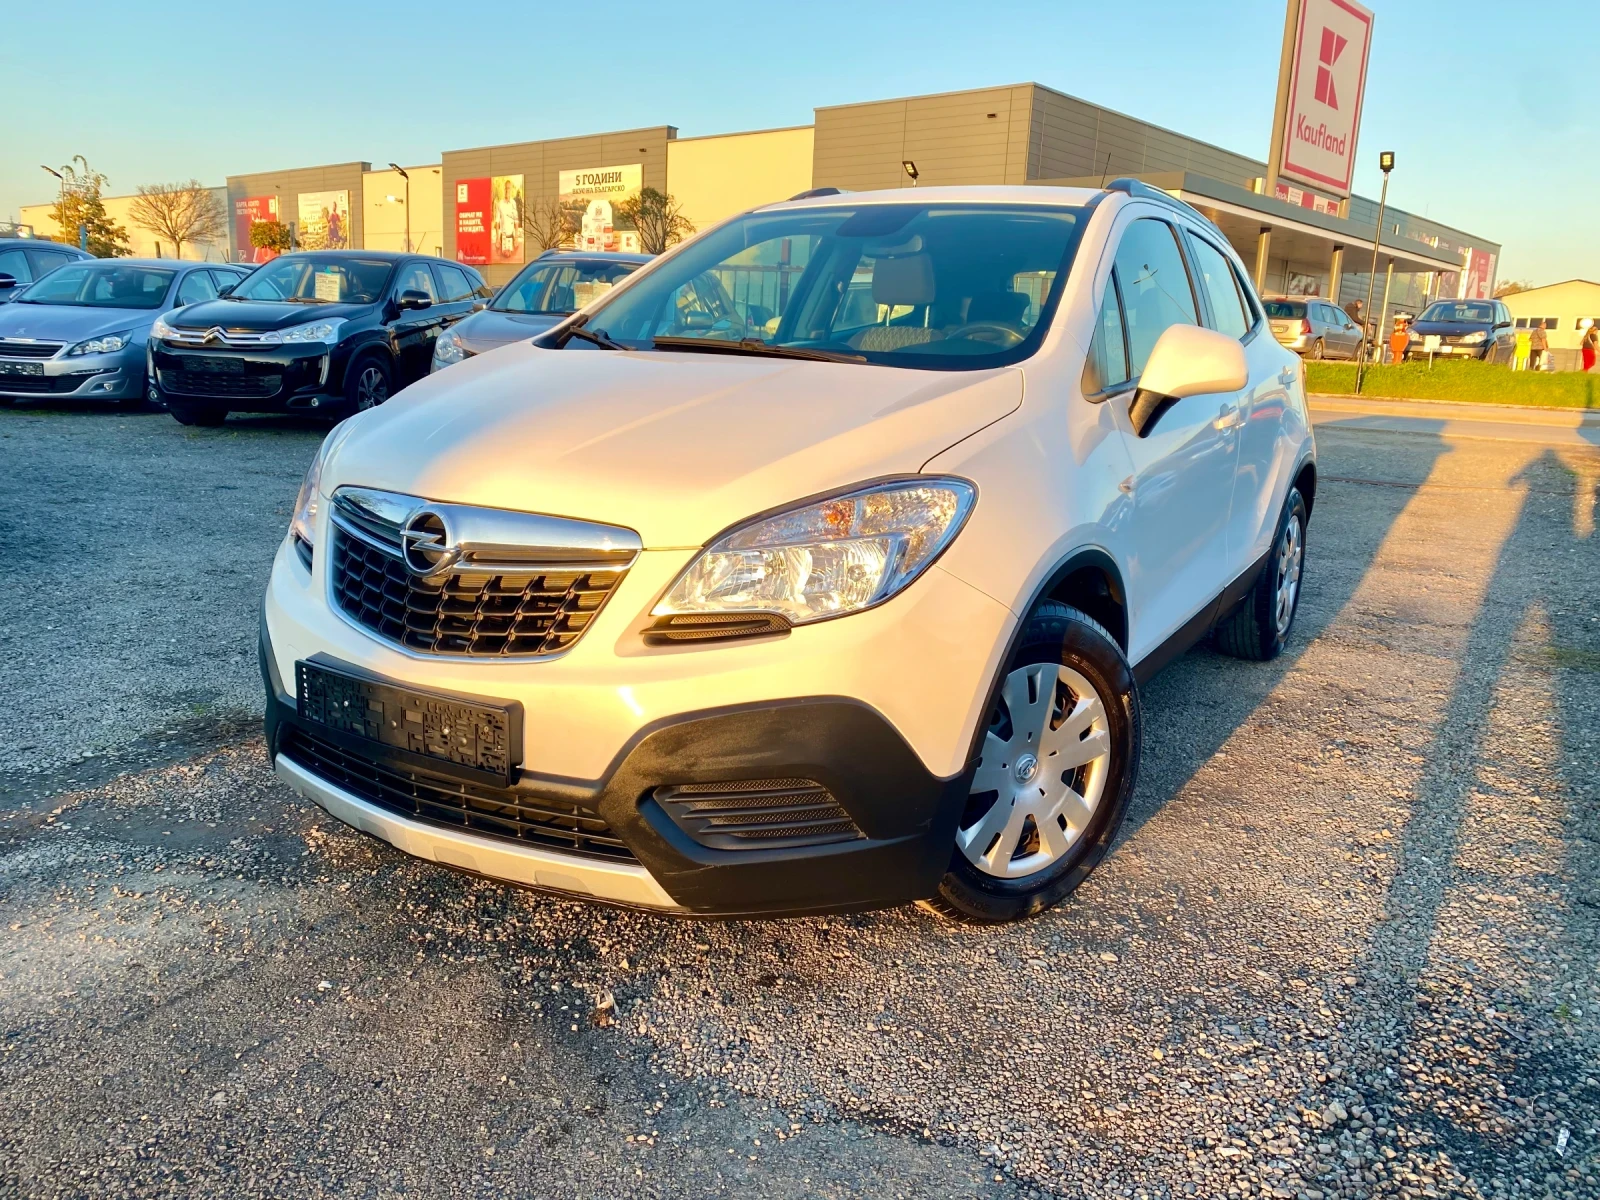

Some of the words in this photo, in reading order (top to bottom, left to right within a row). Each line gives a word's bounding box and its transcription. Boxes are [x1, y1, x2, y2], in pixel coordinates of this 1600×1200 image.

[1296, 112, 1347, 157] Kaufland
[575, 174, 581, 186] 5
[582, 171, 622, 186] ГОДИНИ
